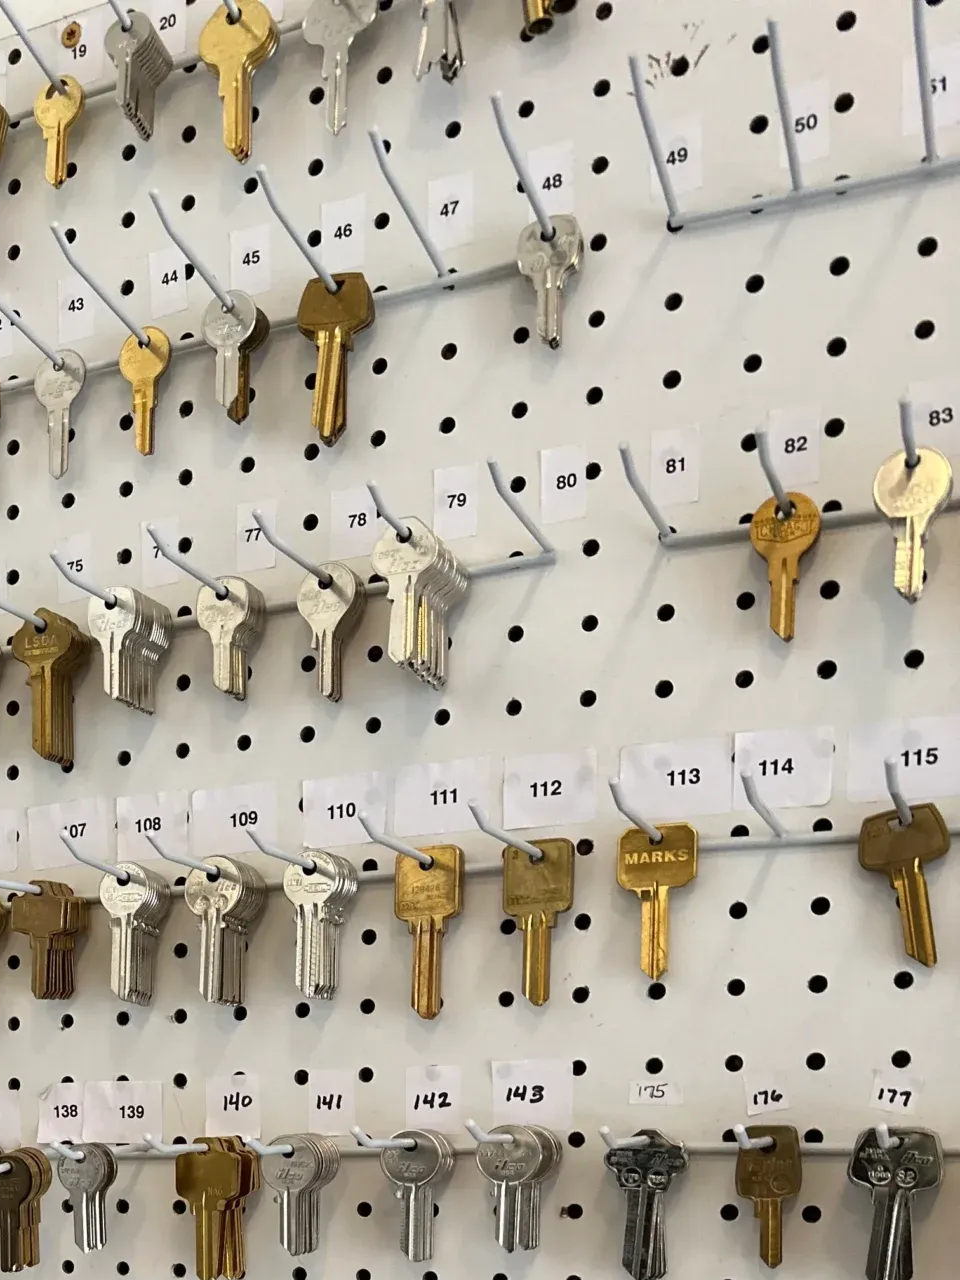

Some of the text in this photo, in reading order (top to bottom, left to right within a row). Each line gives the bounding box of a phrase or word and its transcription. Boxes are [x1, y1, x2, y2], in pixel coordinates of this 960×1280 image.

[159, 14, 177, 30] 20
[71, 44, 87, 60] 19
[795, 114, 818, 132] 50
[666, 147, 688, 166] 49
[542, 173, 563, 191] 48
[440, 200, 460, 218] 47
[333, 223, 353, 240] 46
[242, 250, 261, 266] 45
[161, 269, 179, 285] 44
[68, 297, 85, 313] 43
[929, 407, 954, 426] 83
[784, 436, 808, 454] 82
[666, 457, 686, 474] 81
[556, 473, 577, 490] 80
[447, 493, 466, 508] 79
[348, 513, 366, 528] 78
[245, 527, 262, 542] 77
[67, 560, 83, 572] 75
[25, 634, 57, 648] LSDA
[901, 748, 938, 767] 115
[759, 758, 794, 775] 114
[667, 768, 701, 786] 113
[530, 780, 562, 797] 112
[431, 789, 458, 805] 111
[230, 811, 257, 827] 109
[327, 803, 356, 819] 110
[135, 817, 161, 833] 108
[624, 848, 689, 865] MARKS
[506, 1085, 544, 1103] 143
[638, 1083, 668, 1099] 175
[753, 1090, 783, 1105] 176
[878, 1088, 912, 1106] 177
[223, 1095, 253, 1111] 140
[316, 1095, 342, 1109] 141
[414, 1093, 452, 1109] 142
[53, 1105, 78, 1118] 138
[119, 1105, 144, 1119] 139
